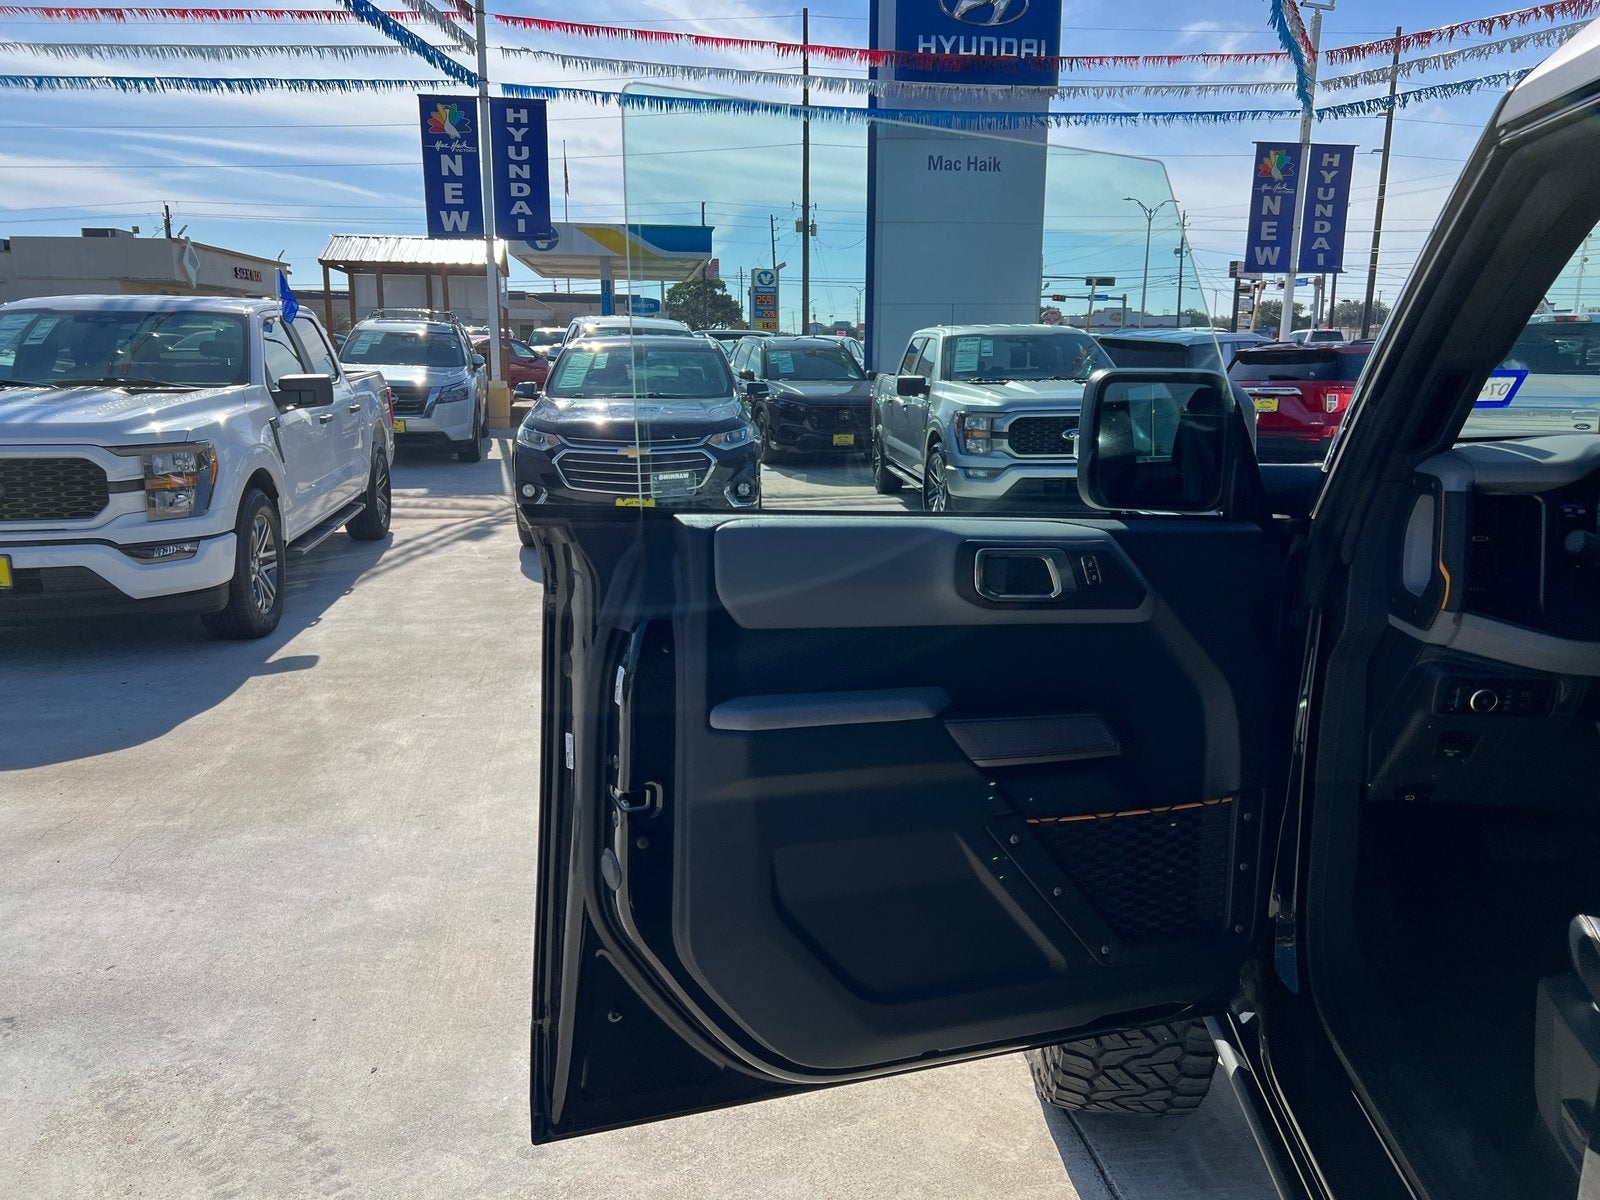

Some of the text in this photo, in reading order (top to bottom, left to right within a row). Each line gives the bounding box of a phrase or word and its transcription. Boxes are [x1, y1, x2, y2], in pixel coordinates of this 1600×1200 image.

[918, 35, 1046, 58] HYUNDAI
[440, 154, 470, 231] NEW
[506, 108, 533, 232] HYUNDAI
[928, 155, 1002, 172] Mac Haik
[1254, 195, 1281, 265] NEW
[1311, 153, 1340, 265] HYUNDAI
